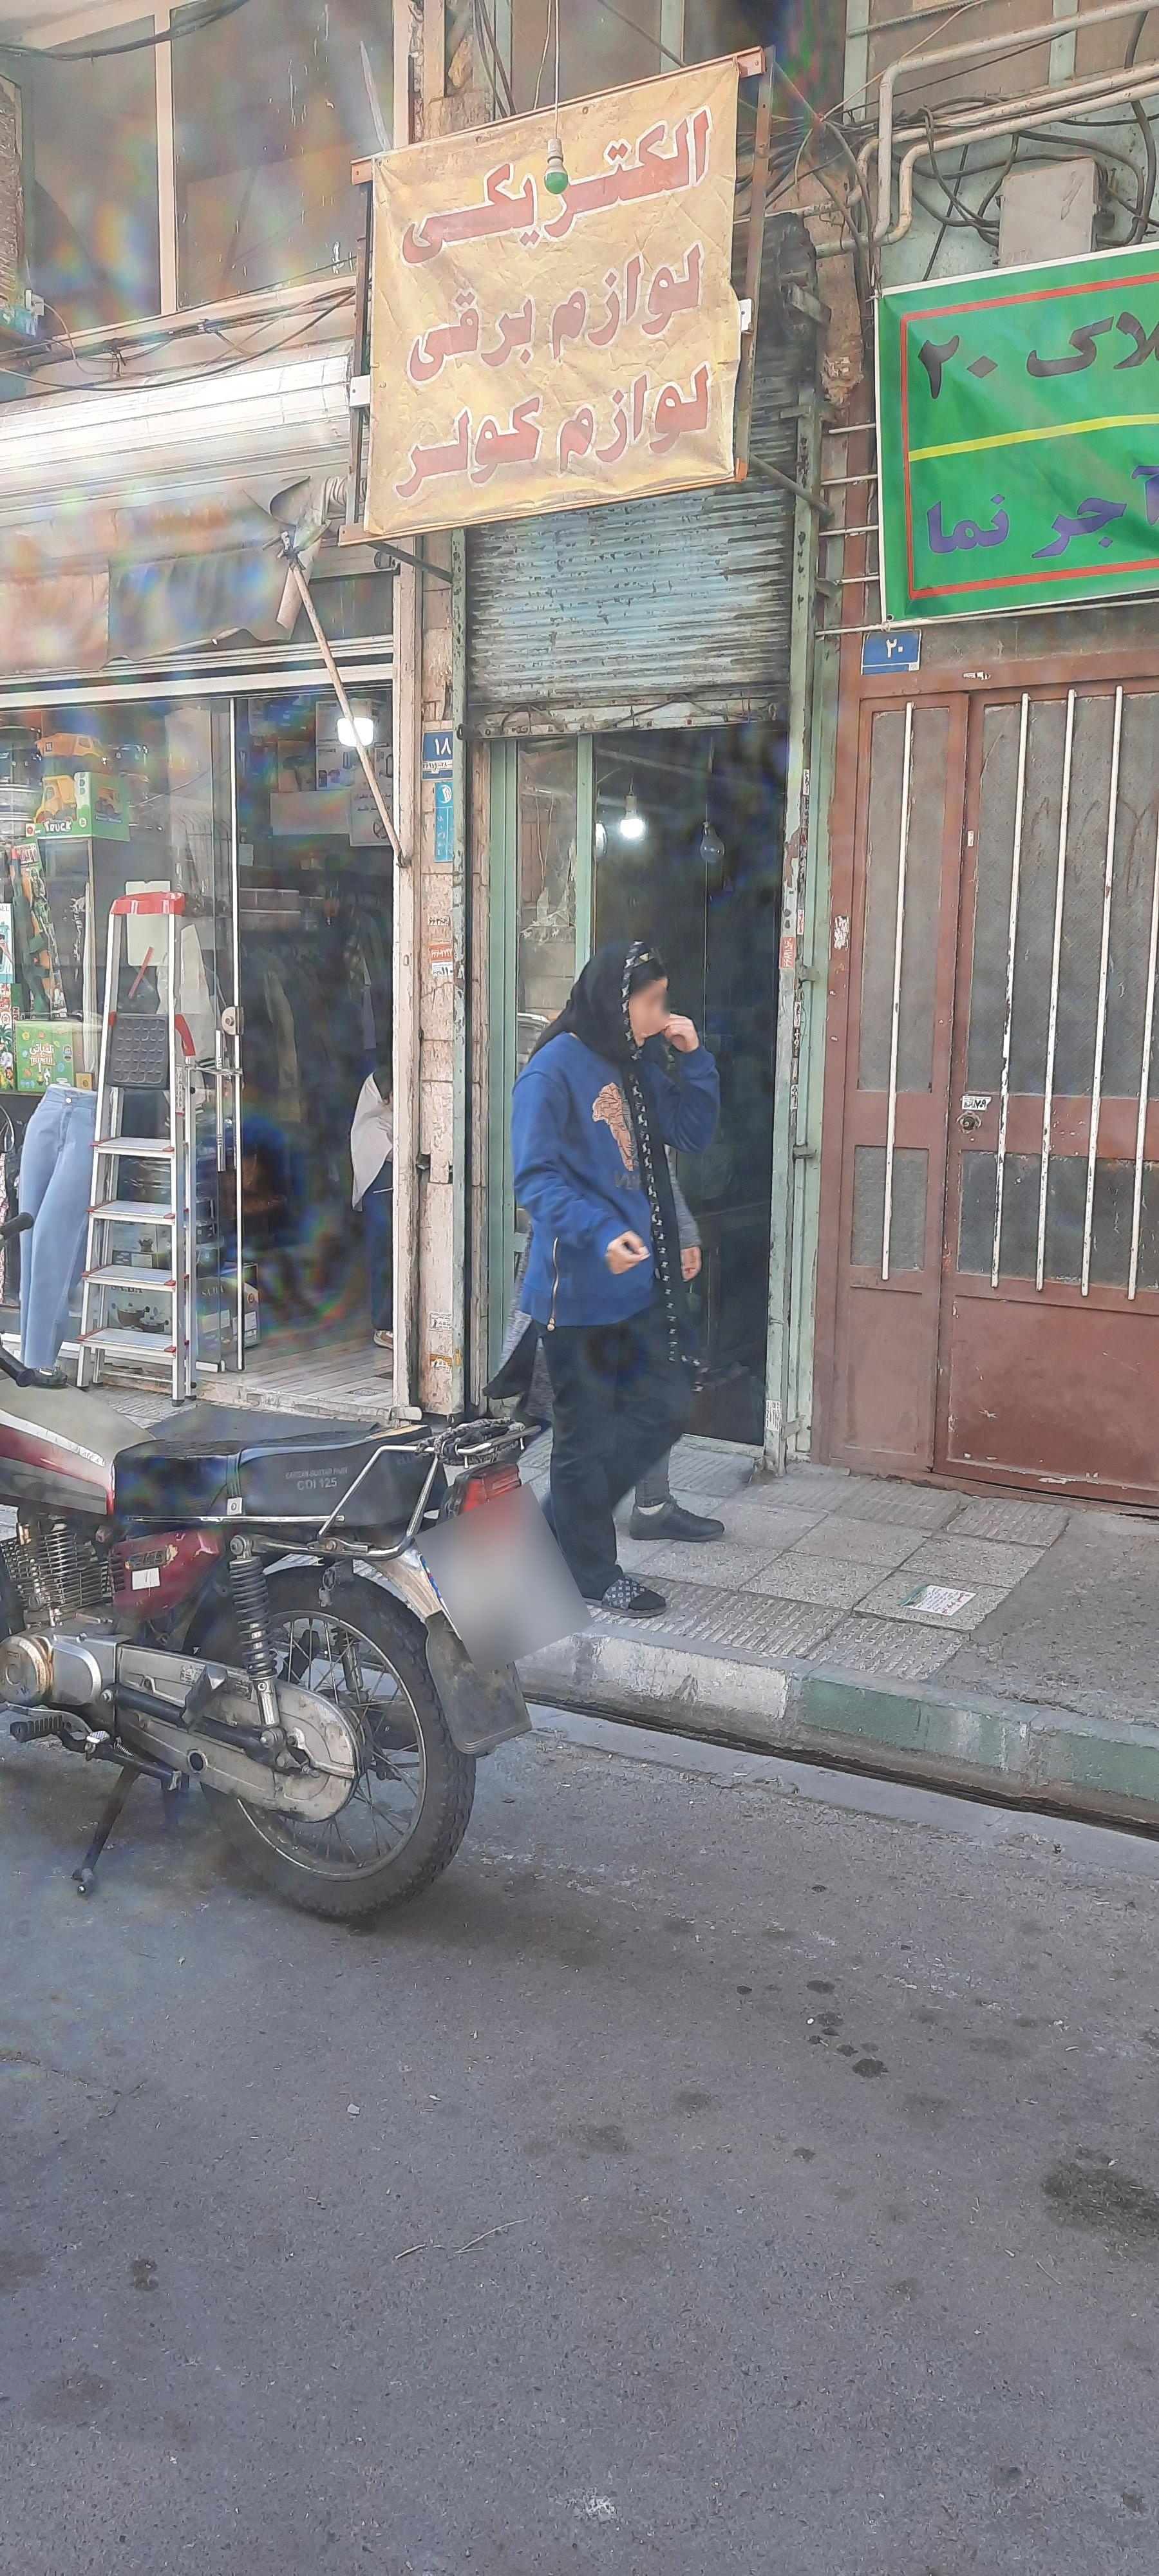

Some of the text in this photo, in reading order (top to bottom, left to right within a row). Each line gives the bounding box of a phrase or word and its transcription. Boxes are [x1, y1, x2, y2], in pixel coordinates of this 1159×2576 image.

[399, 104, 713, 265] الکتریکی
[407, 241, 704, 383] لوازم برقی
[918, 334, 999, 399] ۲۰
[394, 362, 712, 500] لوازم کولر
[926, 493, 1010, 555] نما
[886, 638, 903, 658] ۲۰
[435, 737, 451, 755] ۱۸
[43, 820, 72, 833] TRUCK
[297, 1477, 337, 1490] CDI 125
